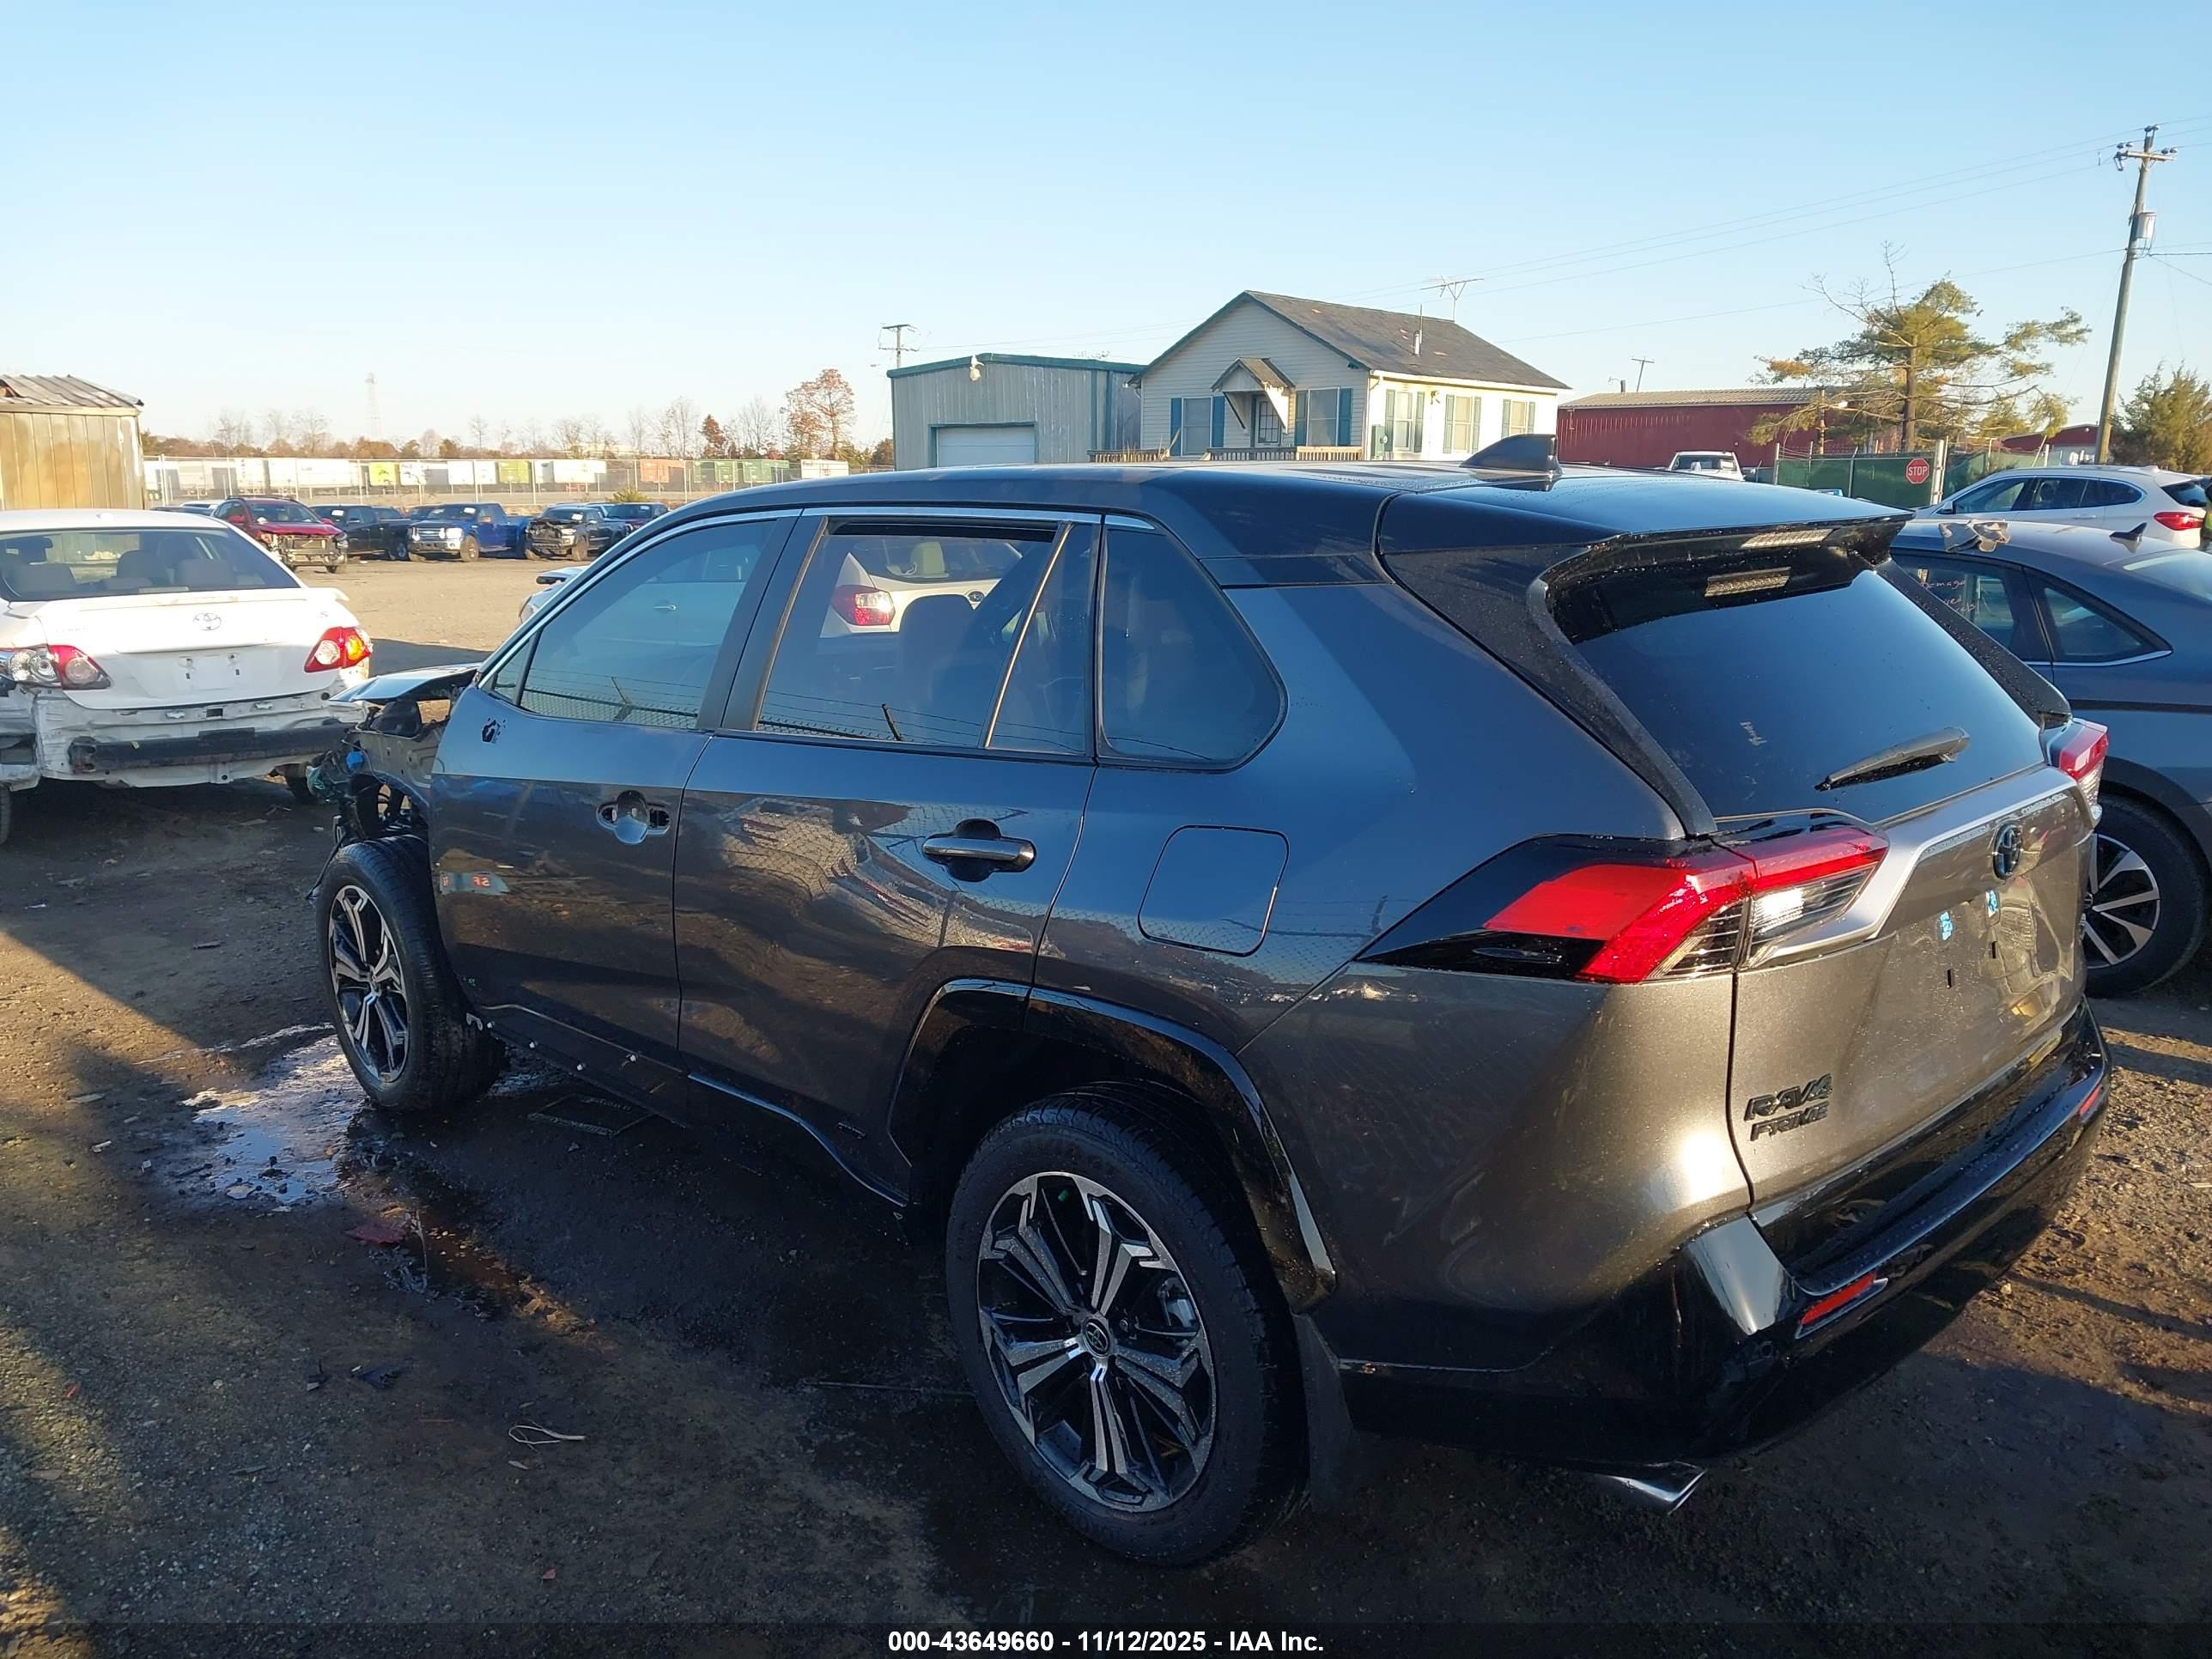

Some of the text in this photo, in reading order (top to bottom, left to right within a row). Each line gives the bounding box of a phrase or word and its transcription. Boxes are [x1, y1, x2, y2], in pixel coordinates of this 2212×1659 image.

[1908, 466, 1928, 476] STOP
[1744, 1073, 1832, 1121] RAV4
[1750, 1101, 1829, 1141] PRIME
